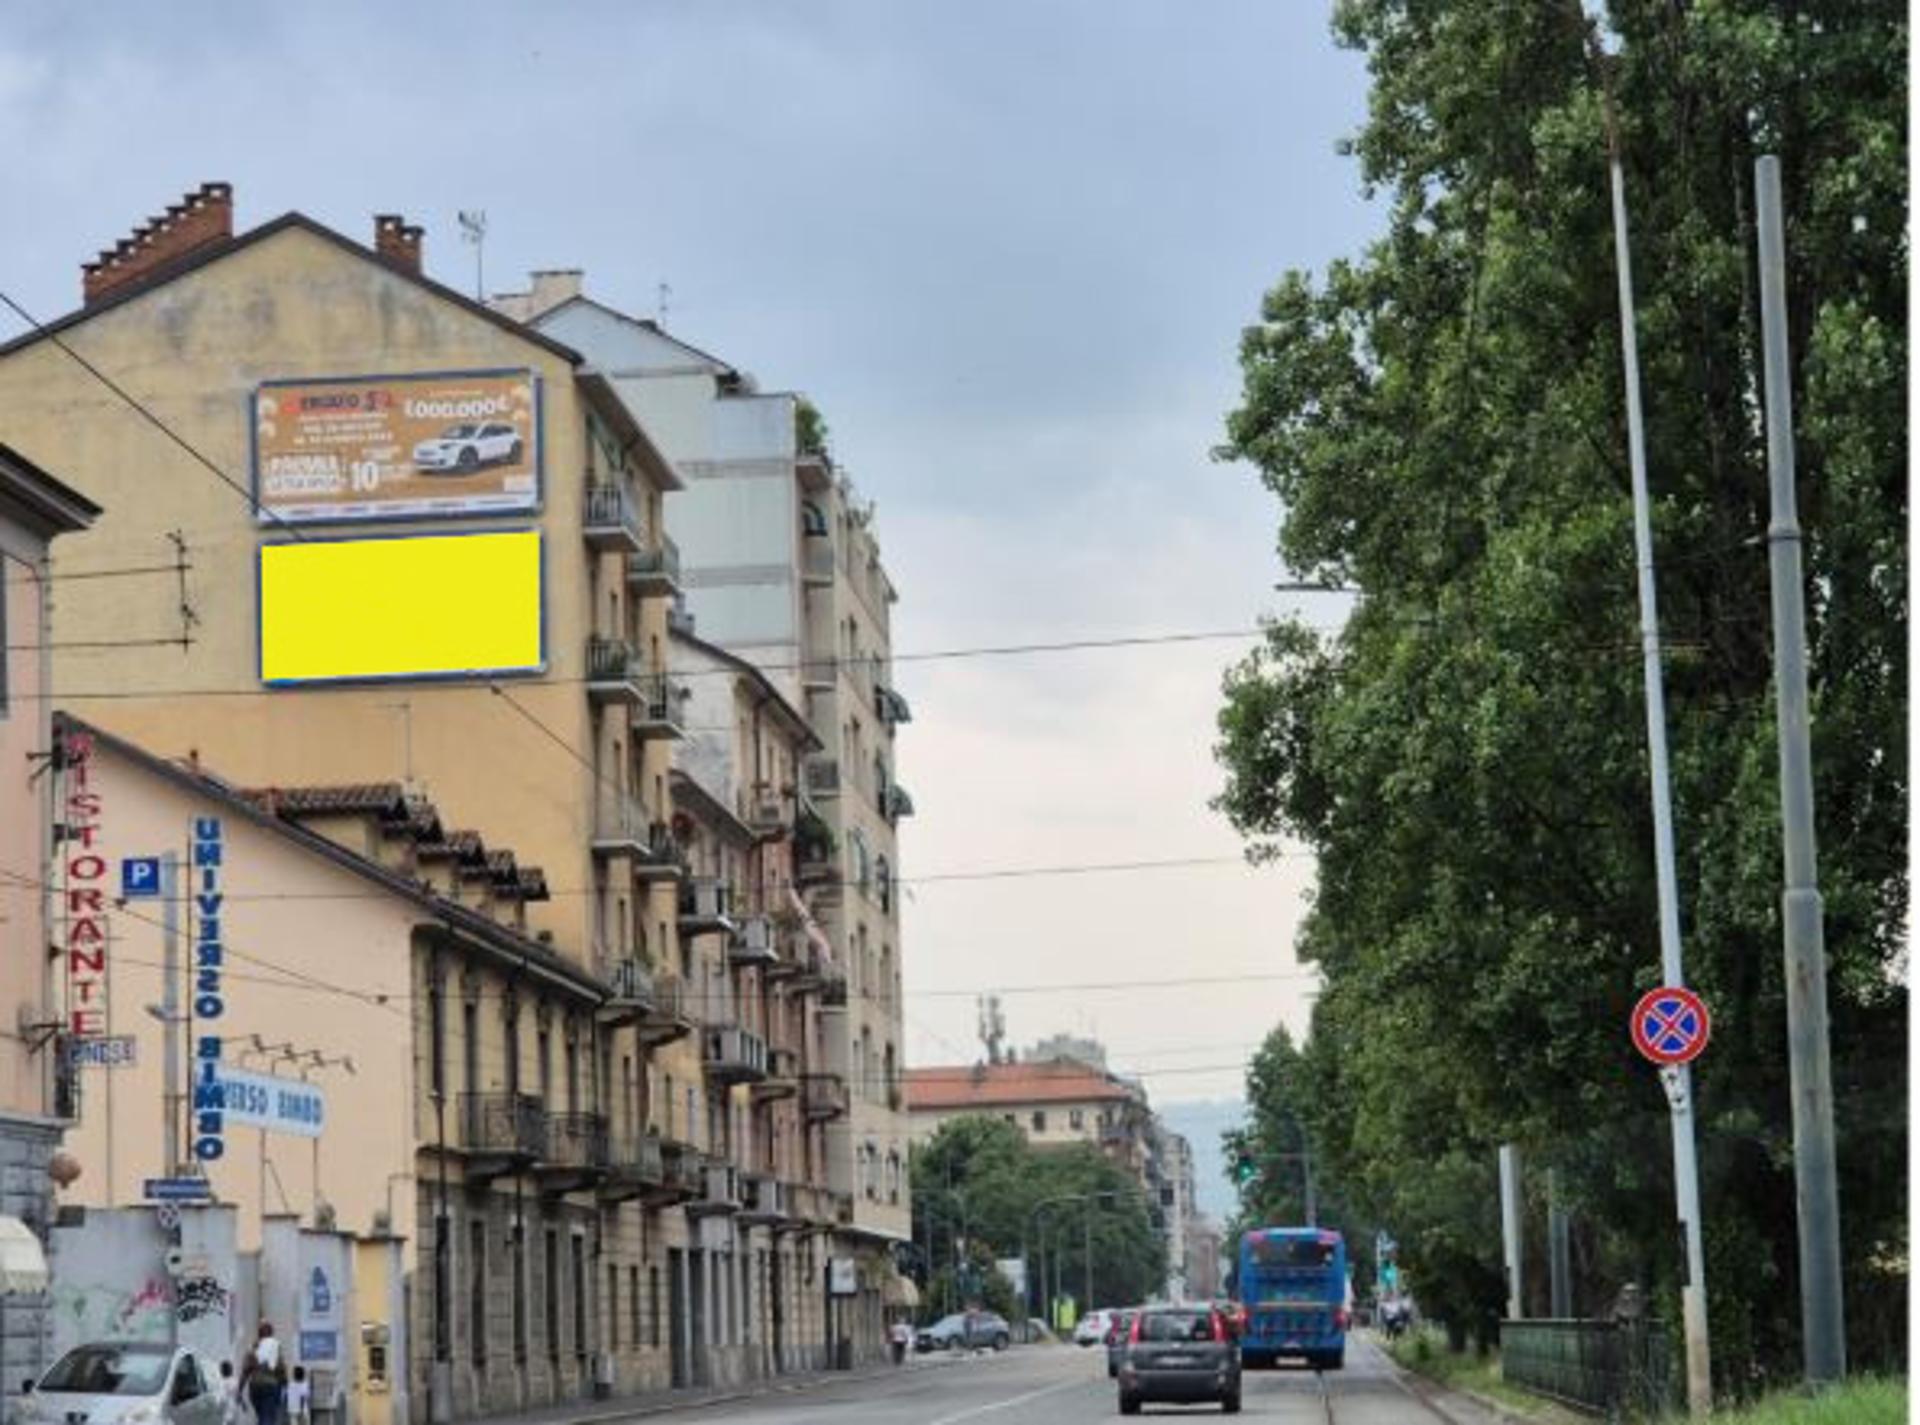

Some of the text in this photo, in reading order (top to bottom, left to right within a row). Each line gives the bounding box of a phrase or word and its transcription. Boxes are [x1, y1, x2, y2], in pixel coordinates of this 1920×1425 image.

[69, 734, 105, 1035] RISTORANTE
[131, 862, 150, 886] P
[194, 817, 226, 1161] UNIVERSO BIMBO
[278, 1090, 322, 1126] BIMBO
